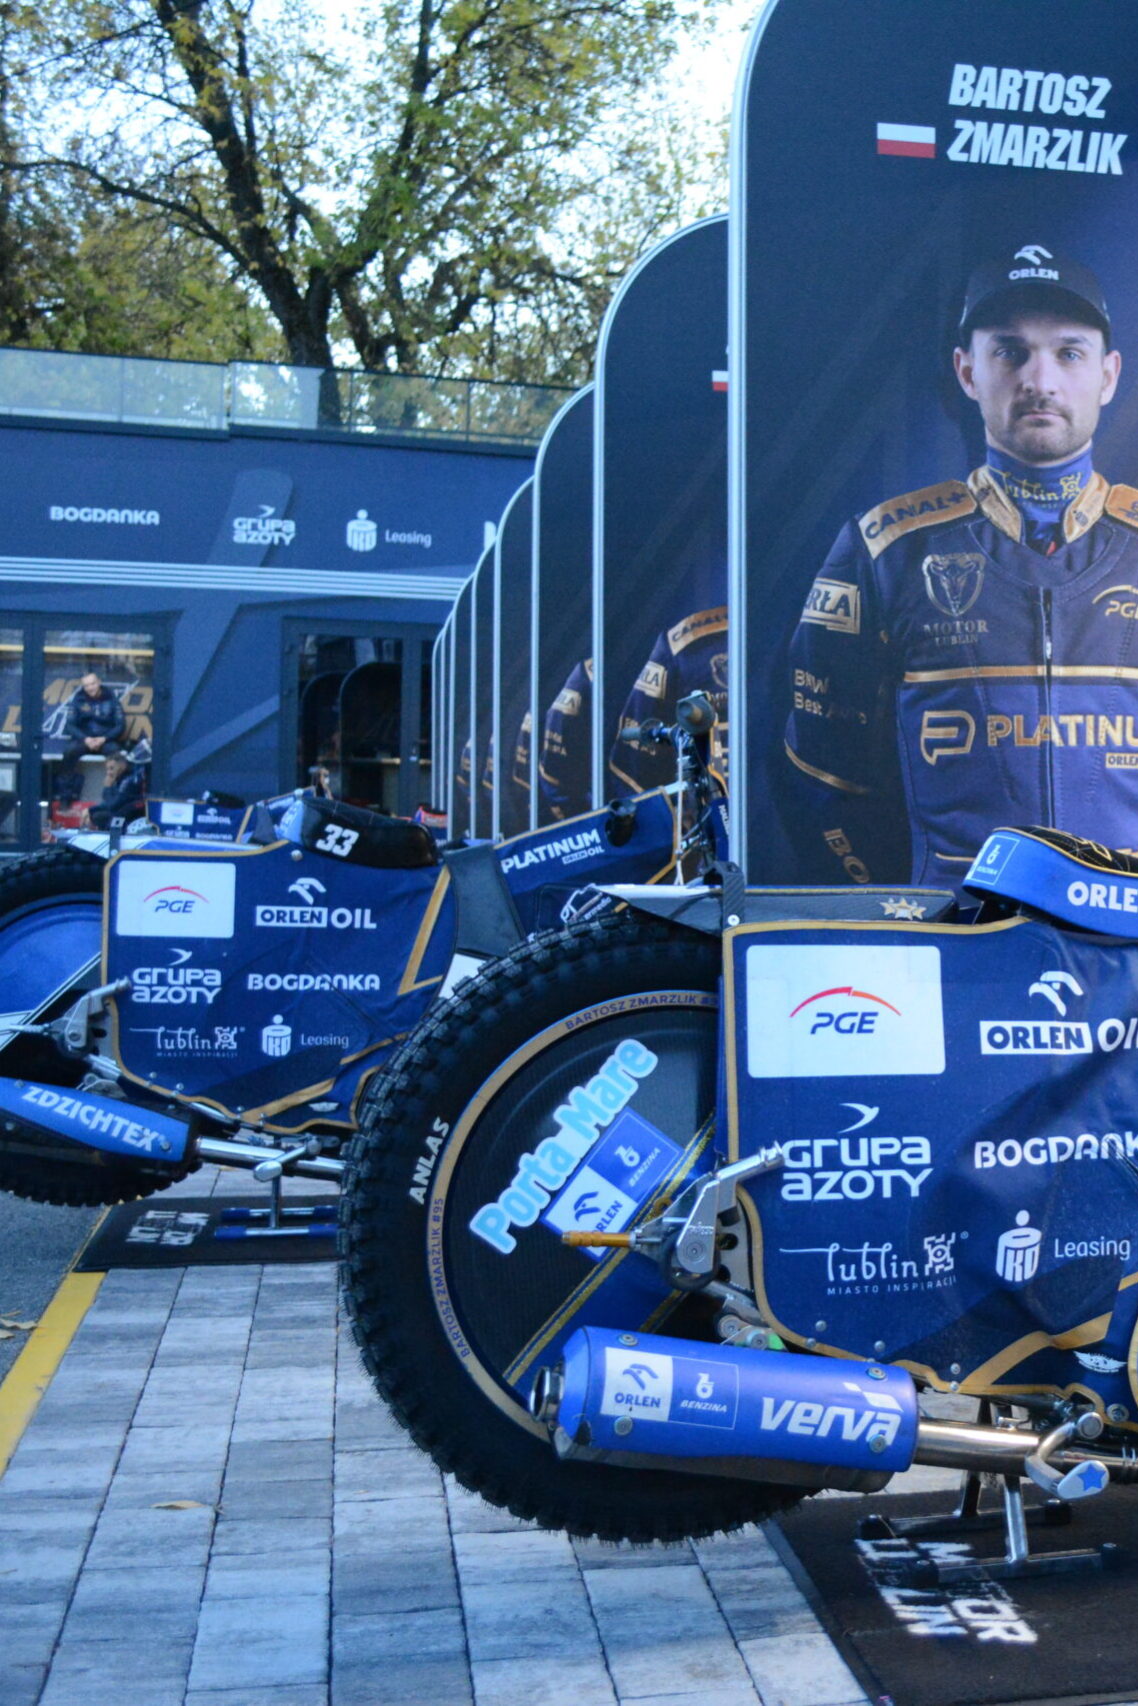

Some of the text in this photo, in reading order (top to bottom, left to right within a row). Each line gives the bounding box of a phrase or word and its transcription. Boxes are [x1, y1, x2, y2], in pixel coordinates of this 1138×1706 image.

[948, 63, 1113, 120] BARTOSZ
[946, 119, 1128, 176] ZMARZLIK
[1008, 267, 1060, 281] ORLEN
[49, 505, 161, 526] BOGDANKA
[384, 528, 433, 549] Leasing
[922, 618, 989, 638] MOTOR
[315, 822, 360, 858] 33
[500, 828, 601, 874] PLATINUM
[587, 844, 606, 858] OIL
[154, 899, 196, 913] PGE
[260, 907, 377, 929] ORLEN OIL
[247, 973, 381, 991] BOGDANKA
[564, 1000, 626, 1031] BARTOSZ
[629, 993, 697, 1009] ZMARZLIK
[810, 1011, 879, 1035] PGE
[300, 1033, 349, 1049] Leasing
[987, 1025, 1086, 1050] ORLEN
[21, 1085, 160, 1153] ZDZICHTEX
[470, 1038, 659, 1255] Porta Mare
[782, 1136, 931, 1168] GRUPA
[409, 1116, 451, 1205] ANLAS
[781, 1167, 934, 1201] AZOTY
[1054, 1237, 1131, 1261] Leasing
[431, 1198, 471, 1359] BARTOSZ ZMARZLIK #95
[827, 1277, 957, 1296] MIASTO INSPIRACJI
[613, 1392, 662, 1409] ORLEN
[680, 1399, 728, 1414] BENZINA
[761, 1396, 902, 1446] verva
